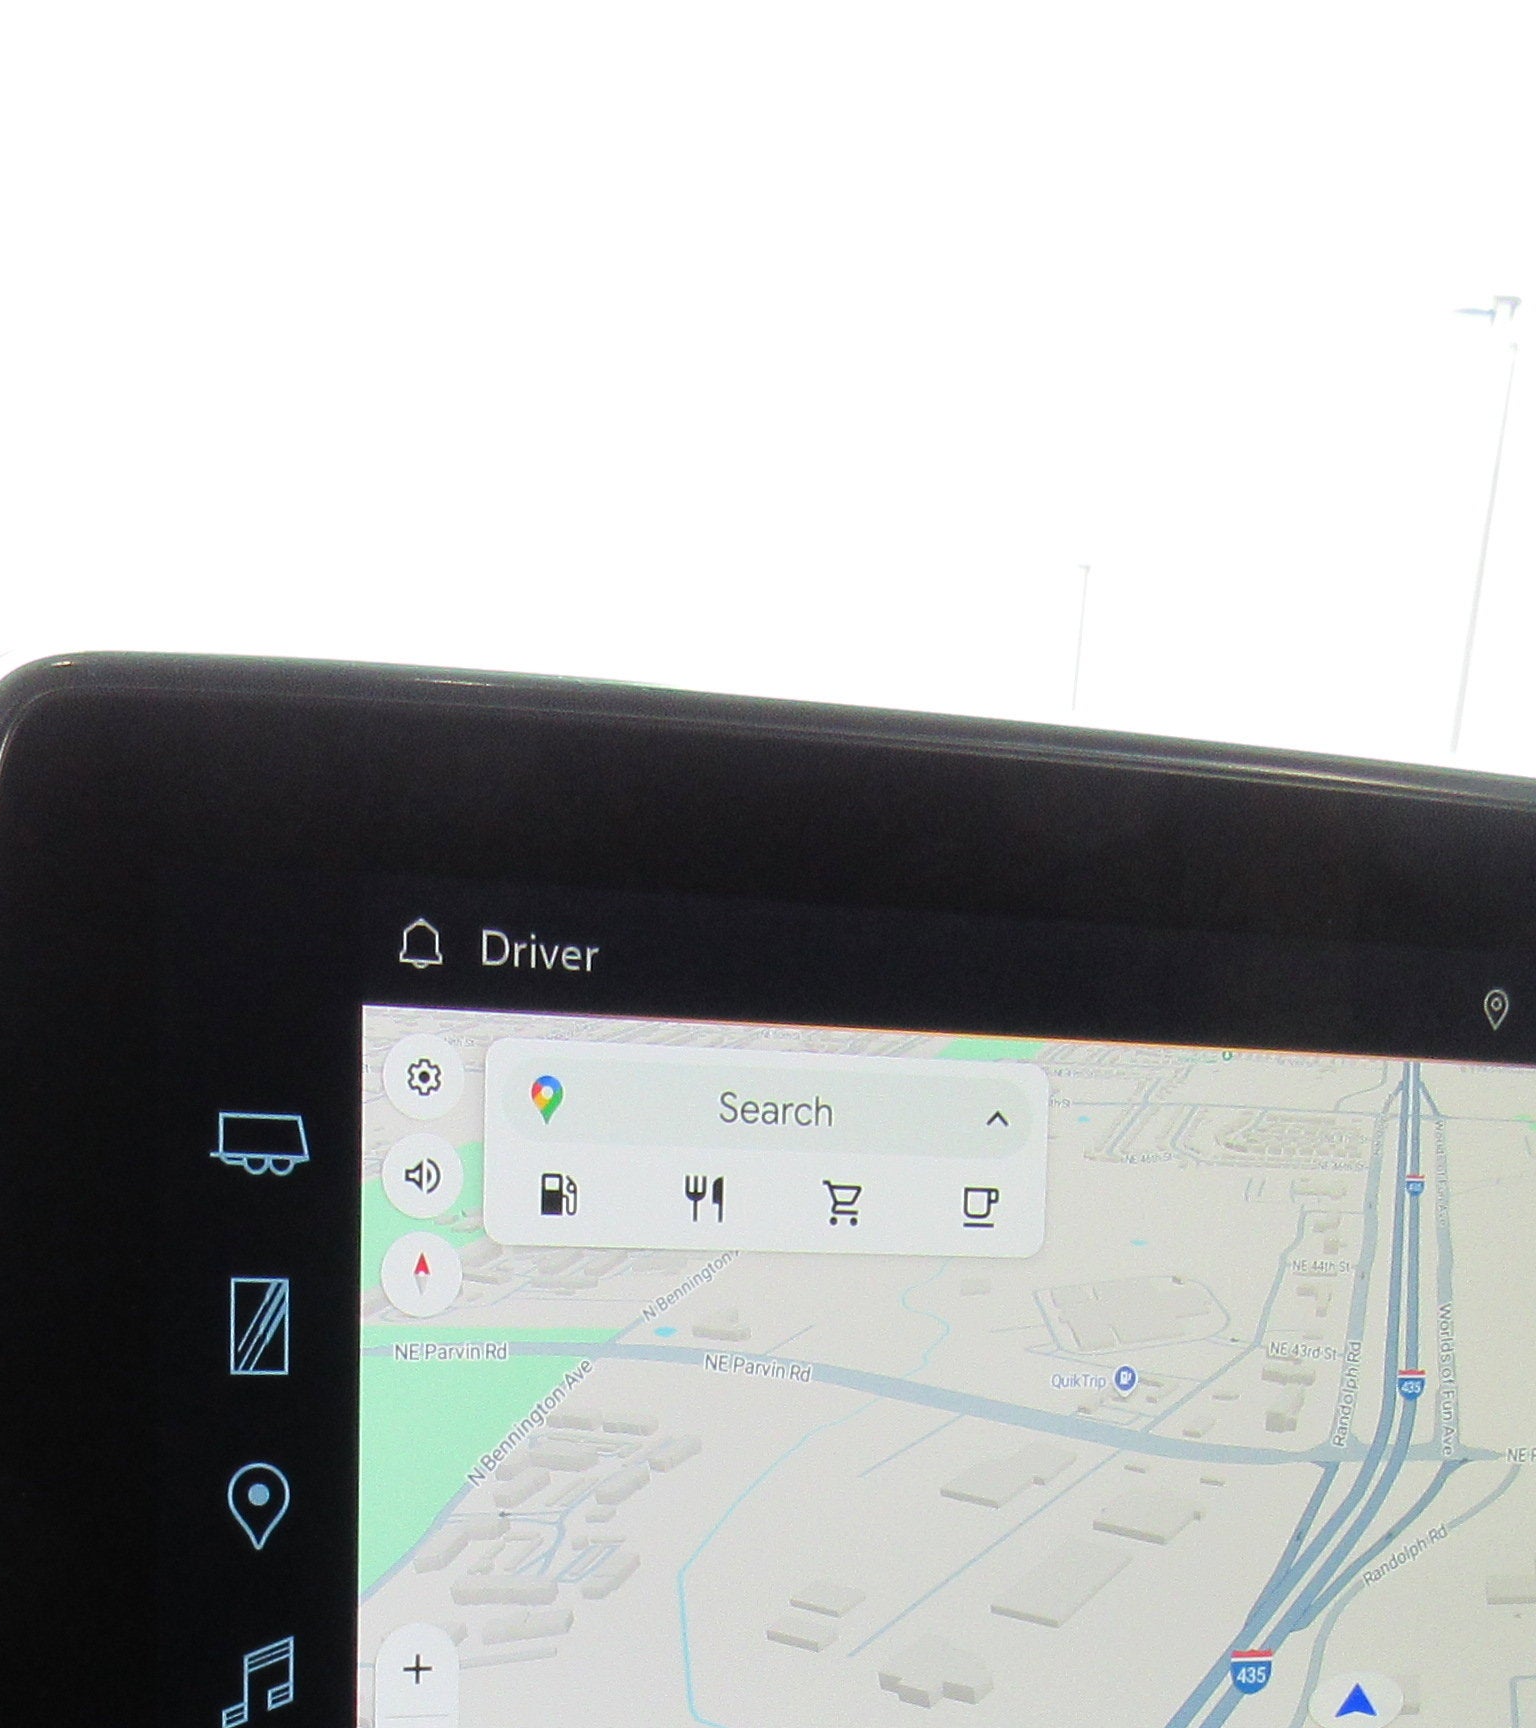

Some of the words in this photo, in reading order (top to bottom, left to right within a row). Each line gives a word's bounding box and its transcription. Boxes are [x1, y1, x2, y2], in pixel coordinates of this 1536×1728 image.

[481, 929, 600, 972] Driver
[719, 1090, 833, 1127] Search
[1292, 1260, 1308, 1272] NE
[1313, 1260, 1336, 1273] 44th
[1339, 1260, 1350, 1273] St
[642, 1304, 658, 1321] N
[655, 1253, 732, 1310] Bennington
[1439, 1303, 1455, 1362] Worlds
[394, 1343, 420, 1361] NE
[425, 1342, 482, 1361] Parvin
[486, 1342, 508, 1361] Rd
[1270, 1341, 1286, 1356] NE
[1291, 1343, 1321, 1360] 43rd
[1324, 1347, 1337, 1361] St
[1347, 1340, 1362, 1363] Rd
[704, 1354, 729, 1373] NE
[733, 1357, 786, 1380] Parvin
[789, 1363, 812, 1383] Rd
[1441, 1367, 1455, 1386] of
[1400, 1380, 1422, 1395] 435
[1333, 1367, 1362, 1448] Randolph
[1441, 1390, 1455, 1421] Fun
[467, 1470, 486, 1488] N
[481, 1386, 565, 1473] Bennington
[563, 1359, 594, 1391] Ave
[1441, 1426, 1456, 1456] Ave
[1507, 1448, 1527, 1462] NE
[1363, 1537, 1428, 1586] Randolph
[1427, 1523, 1448, 1545] Rd
[1236, 1666, 1267, 1684] 435
